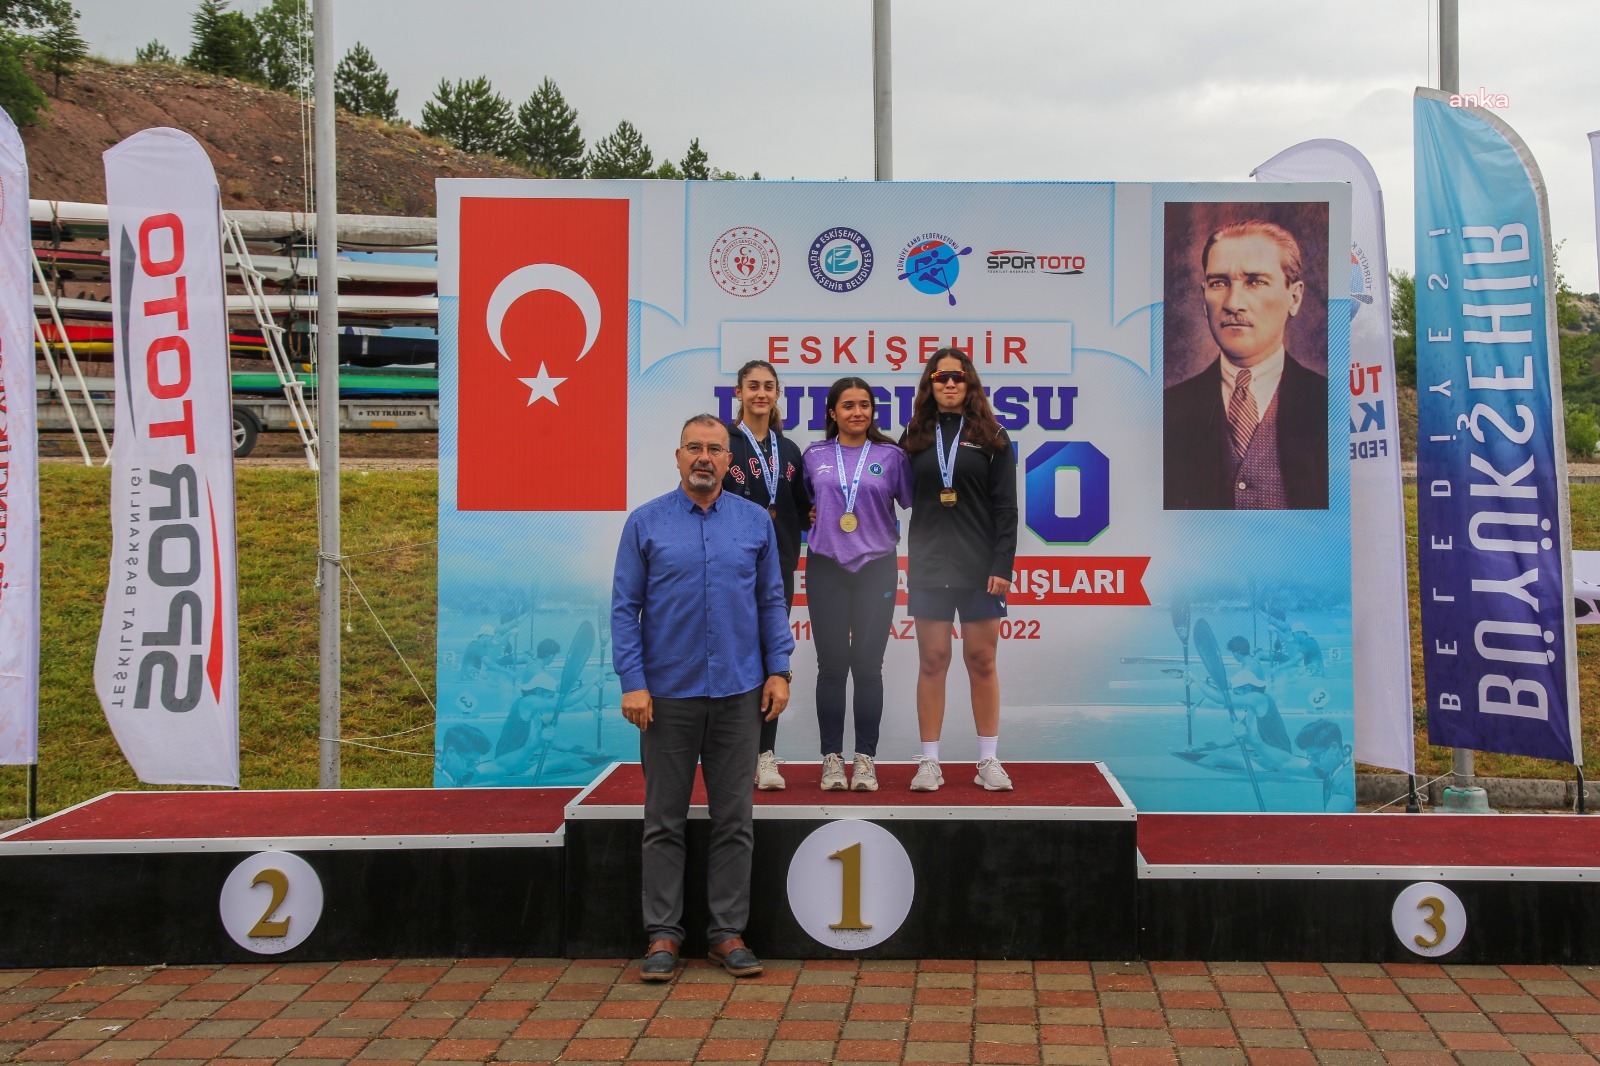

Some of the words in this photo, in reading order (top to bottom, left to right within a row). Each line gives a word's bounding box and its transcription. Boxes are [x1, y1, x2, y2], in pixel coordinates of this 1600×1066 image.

[820, 229, 862, 244] ESKİŞEHİR
[898, 247, 910, 271] TÜRKİYE
[906, 236, 921, 250] KANO
[922, 232, 960, 250] FEDERASYONU
[810, 249, 844, 291] BÜYÜKŞEHİR
[846, 249, 872, 290] BELEDİYESİ
[768, 330, 1028, 371] ESKİŞEHİR
[1000, 620, 1041, 640] 022
[247, 868, 292, 938] 2
[828, 842, 872, 929] 1
[1414, 896, 1448, 948] 3
